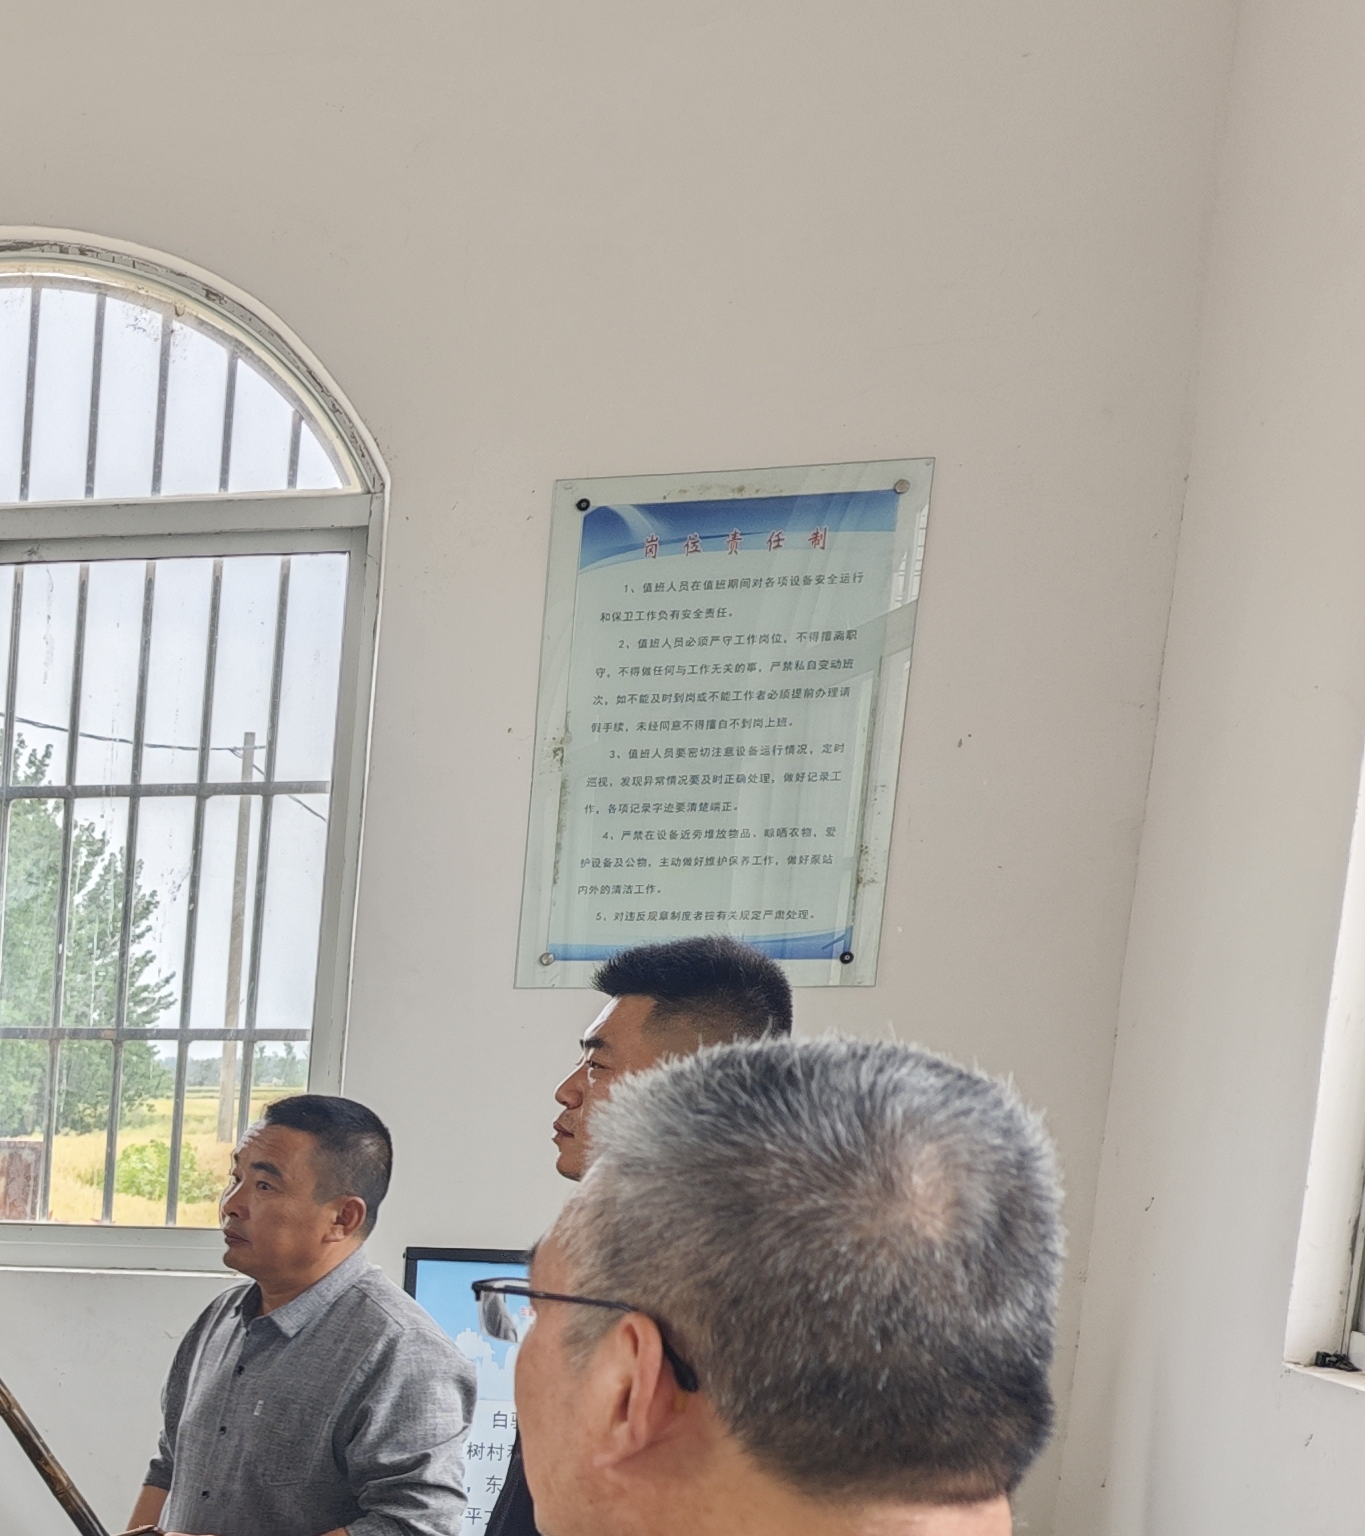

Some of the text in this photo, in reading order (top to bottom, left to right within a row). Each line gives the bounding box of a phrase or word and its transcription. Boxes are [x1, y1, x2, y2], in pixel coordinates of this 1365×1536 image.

[599, 607, 734, 623] 和保卫工作负有安全责任。
